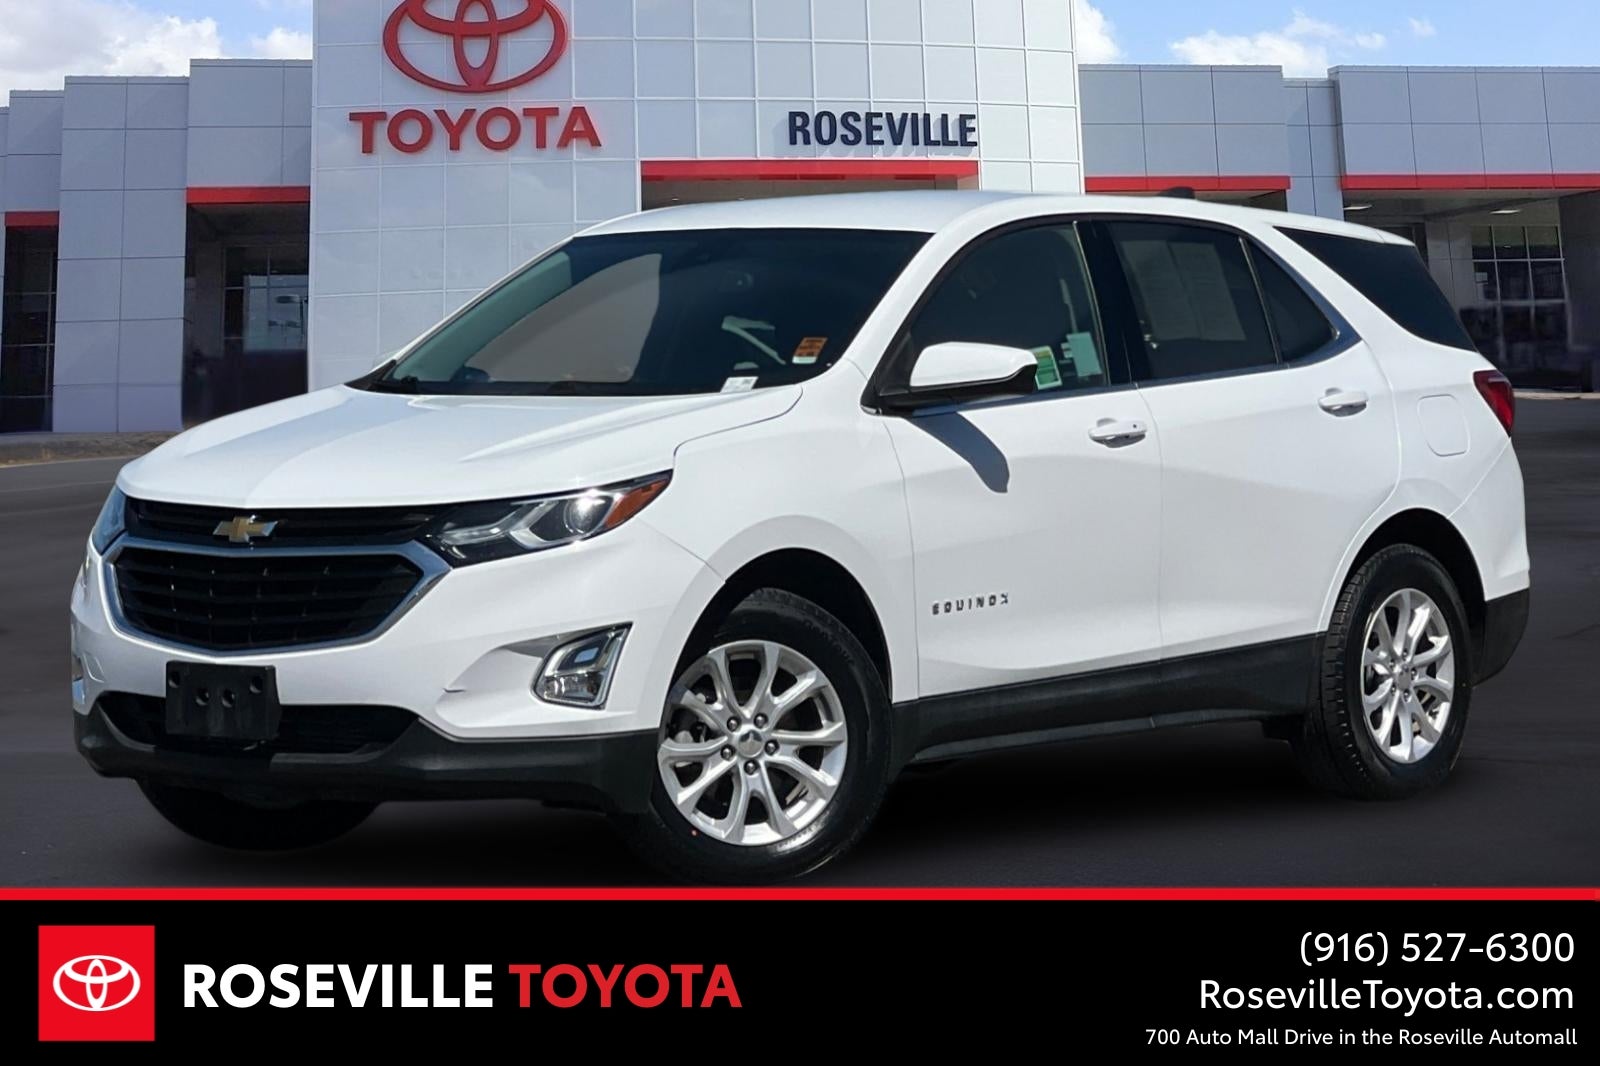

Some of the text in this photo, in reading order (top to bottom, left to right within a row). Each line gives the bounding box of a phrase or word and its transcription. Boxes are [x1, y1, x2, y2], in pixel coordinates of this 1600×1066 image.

[349, 106, 602, 154] TOYOTA
[788, 110, 979, 148] ROSEVILLE
[931, 592, 1010, 616] EQUINOX
